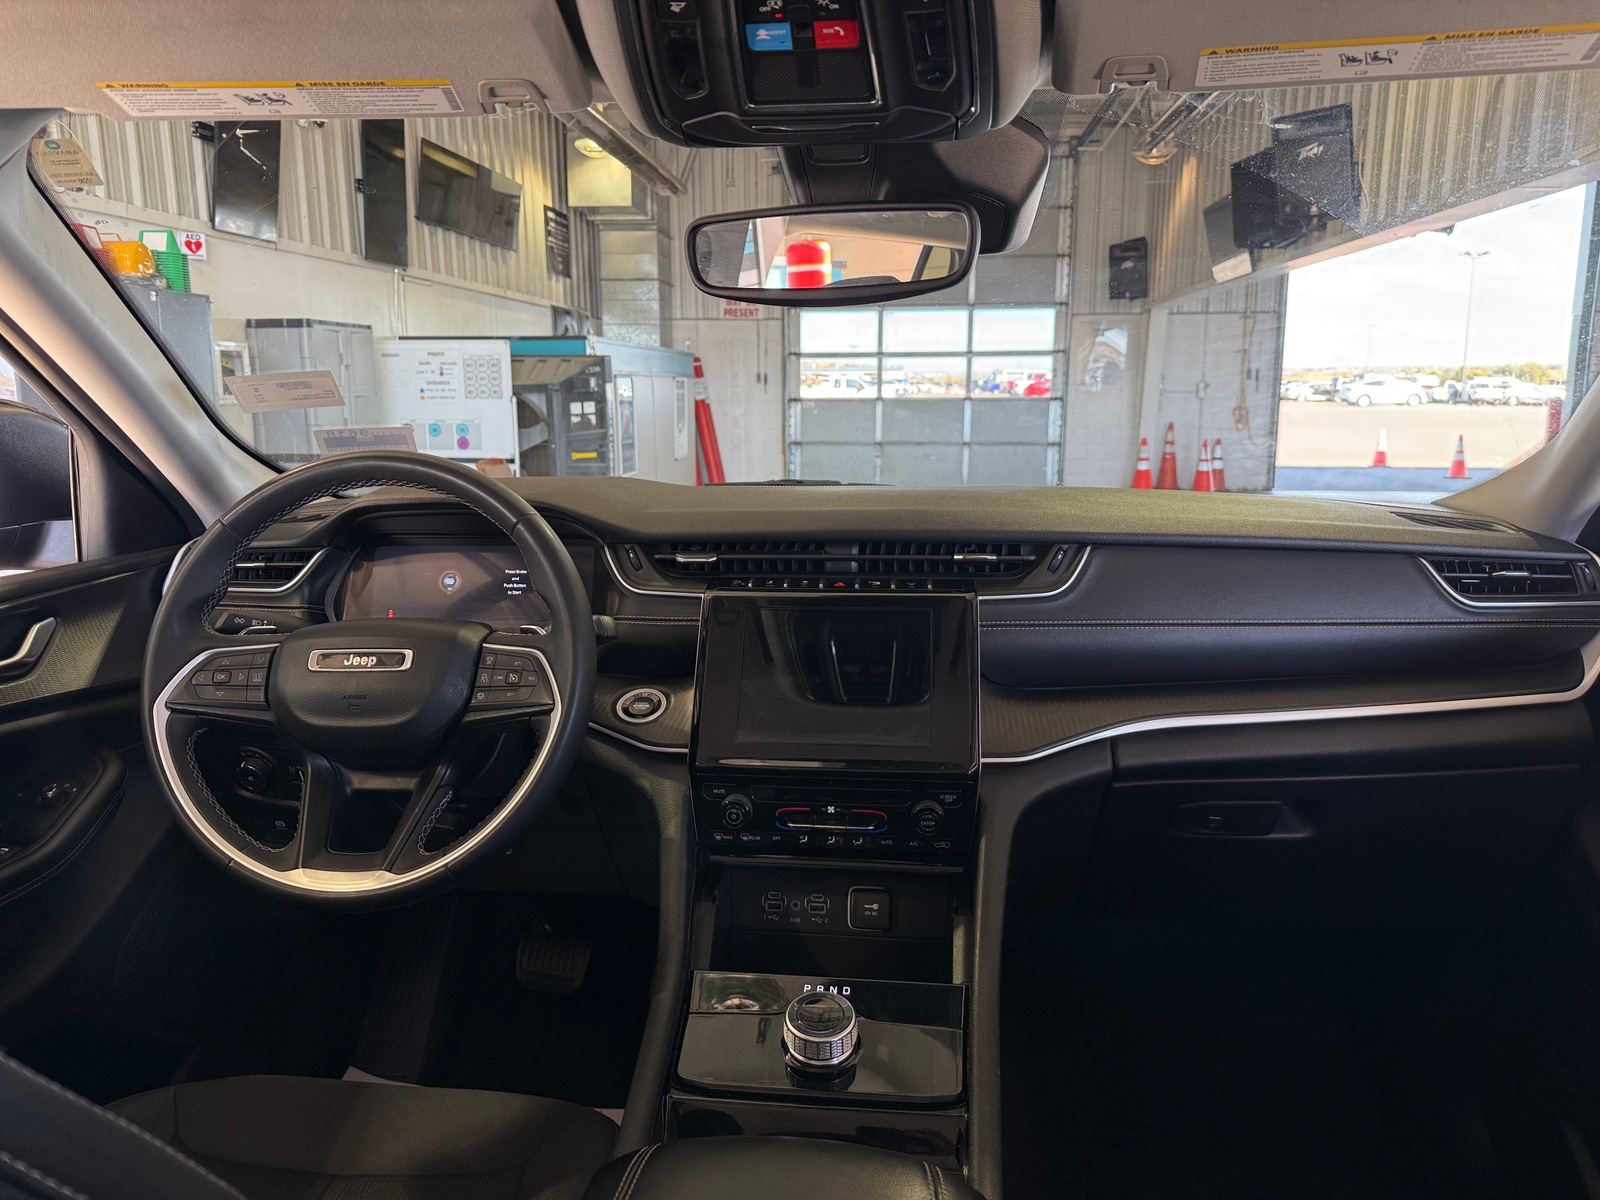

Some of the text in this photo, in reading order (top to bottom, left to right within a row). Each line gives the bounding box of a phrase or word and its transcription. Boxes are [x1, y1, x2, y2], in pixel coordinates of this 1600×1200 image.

[1445, 31, 1474, 40] MISE
[1498, 28, 1541, 37] GARDE
[1225, 45, 1279, 54] WARNING
[36, 149, 80, 157] CARVANA
[185, 233, 201, 241] AED
[723, 307, 759, 318] PRESENT
[343, 654, 377, 667] Jeep
[803, 984, 851, 995] P R N D
